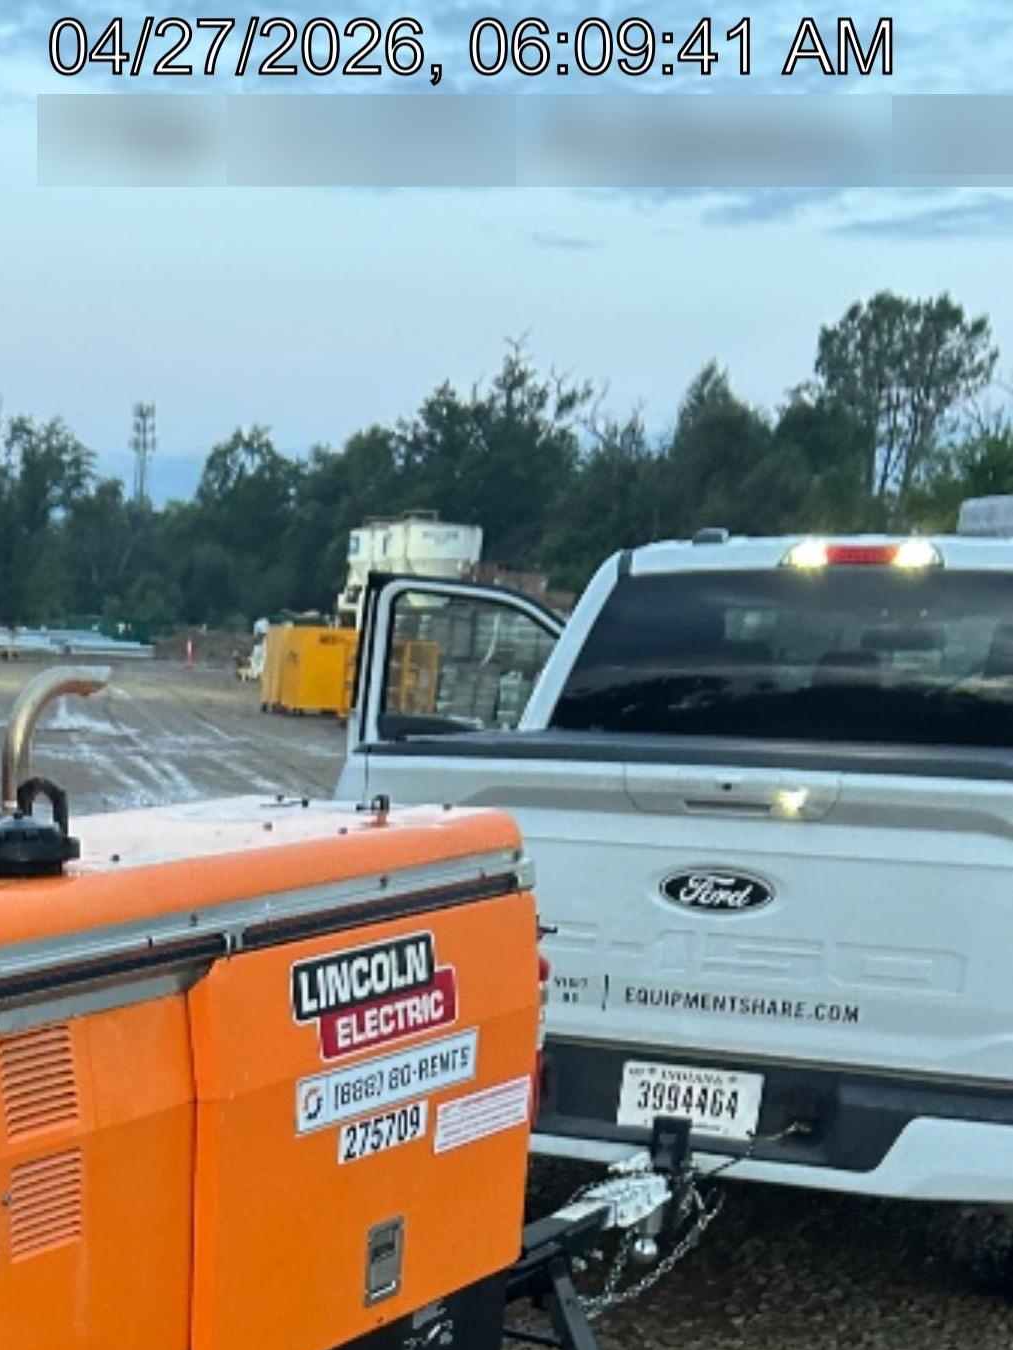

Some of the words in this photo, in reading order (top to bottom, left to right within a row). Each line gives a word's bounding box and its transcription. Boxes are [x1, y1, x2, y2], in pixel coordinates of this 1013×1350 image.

[680, 874, 754, 908] Ford
[299, 941, 429, 1013] LINCOLN
[625, 986, 860, 1024] EQUIPMENTSHARE.COM
[335, 989, 445, 1048] ELECTRIC
[343, 1104, 421, 1162] 275709
